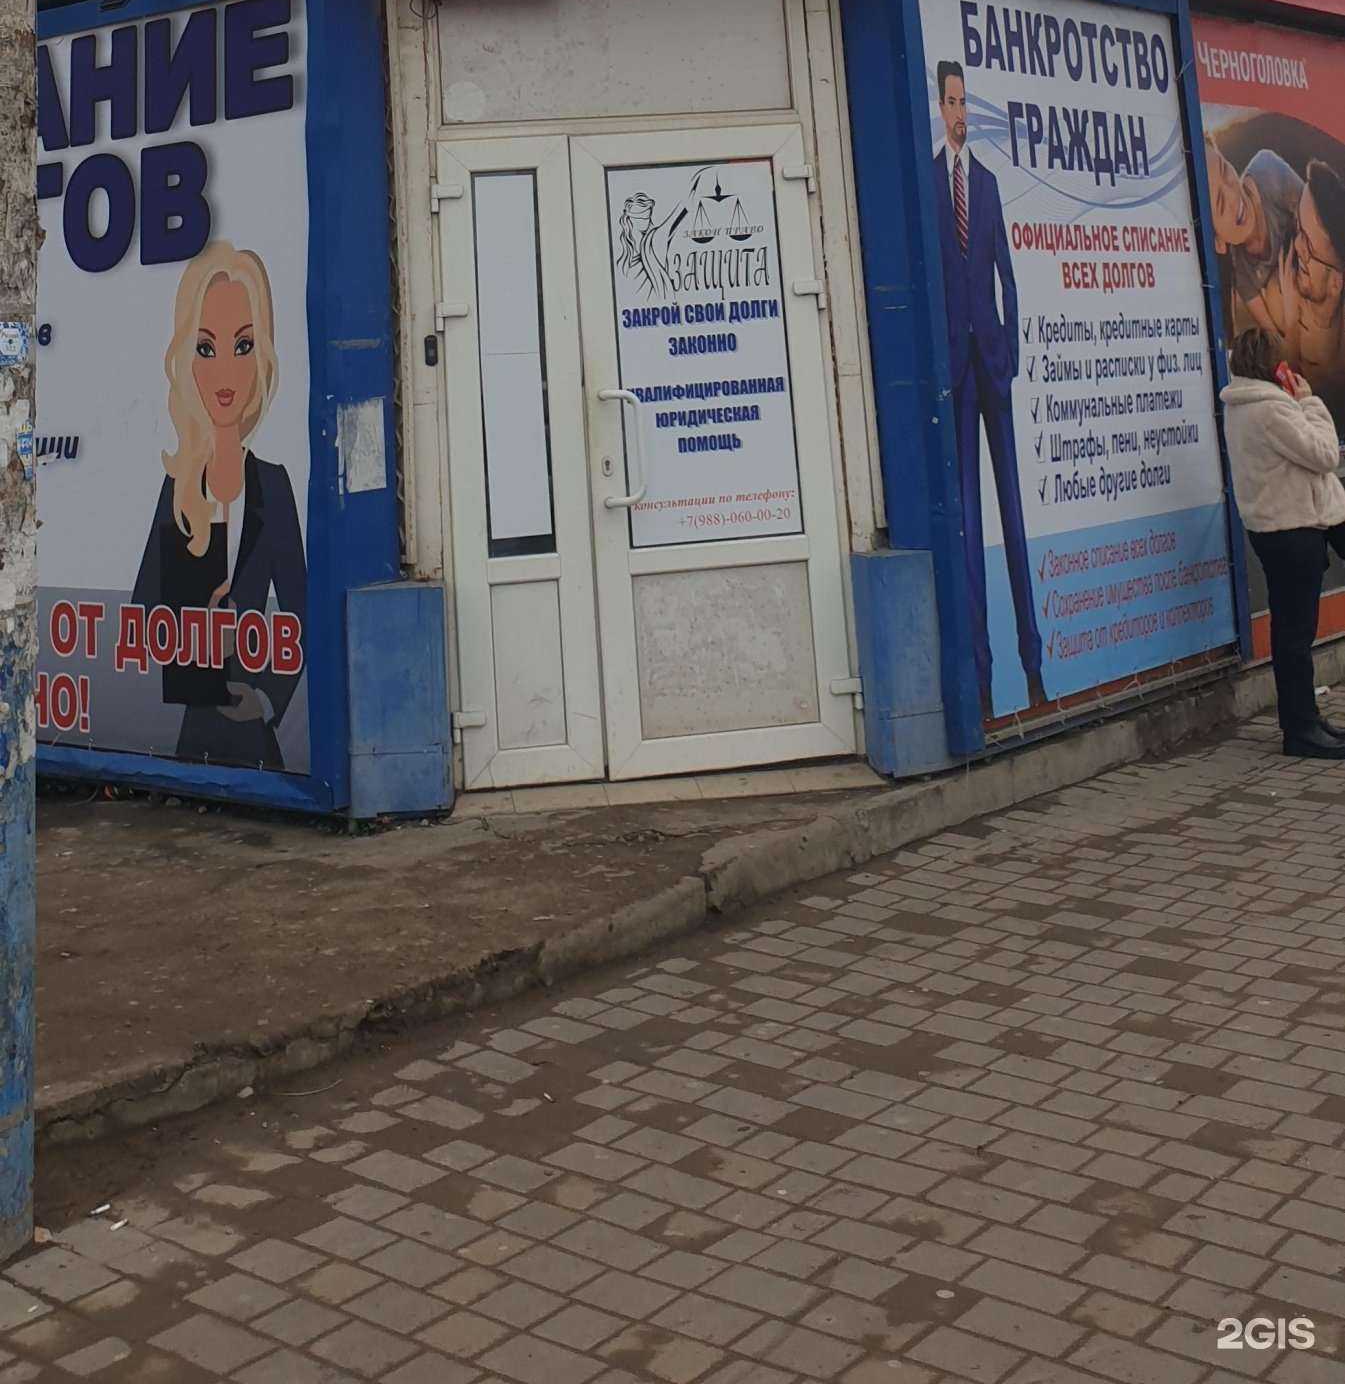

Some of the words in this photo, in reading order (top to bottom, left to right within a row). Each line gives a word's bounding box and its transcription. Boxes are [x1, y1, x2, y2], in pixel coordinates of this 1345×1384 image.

[960, 0, 1169, 94] БАНКРОТСТВО
[1197, 40, 1309, 89] ЧЕРНОГОЛОВКА
[1007, 101, 1150, 187] ГРАЖДАН
[1011, 221, 1119, 256] ОФИЦИАЛЬНОЕ
[1122, 225, 1190, 252] СПИСАНИЕ
[672, 246, 770, 300] ЗАЩИТА
[1062, 262, 1099, 289] ВСЕХ
[1102, 262, 1155, 294] ДОЛГОВ
[622, 302, 681, 328] ЗАКРОЙ
[685, 302, 725, 324] СВОИ
[729, 299, 779, 323] ДОЛГИ
[1038, 314, 1097, 349] Кредиты,
[1100, 312, 1162, 347] кредитные
[1165, 317, 1200, 343] карты
[668, 333, 737, 356] ЗАКОННО
[1042, 354, 1082, 383] Займы
[1085, 360, 1092, 379] и
[1095, 355, 1146, 385] расписки
[1149, 356, 1154, 381] у
[1157, 348, 1181, 380] физ.
[1183, 352, 1203, 376] лиц
[656, 405, 760, 428] ЮРИДИЧЕСКАЯ
[1046, 393, 1133, 427] Коммунальные
[1136, 389, 1183, 413] платежи
[678, 433, 741, 453] ПОМОЩЬ
[1050, 429, 1109, 465] Штрафы,
[1112, 432, 1141, 456] пени,
[1144, 419, 1200, 456] неустойки
[718, 495, 732, 504] по
[736, 488, 795, 504] телефону:
[1054, 471, 1096, 503] Любые
[1099, 466, 1138, 502] другие
[1140, 460, 1171, 490] долги
[51, 600, 104, 658] ОТ
[115, 604, 304, 675] ДОЛГОВ
